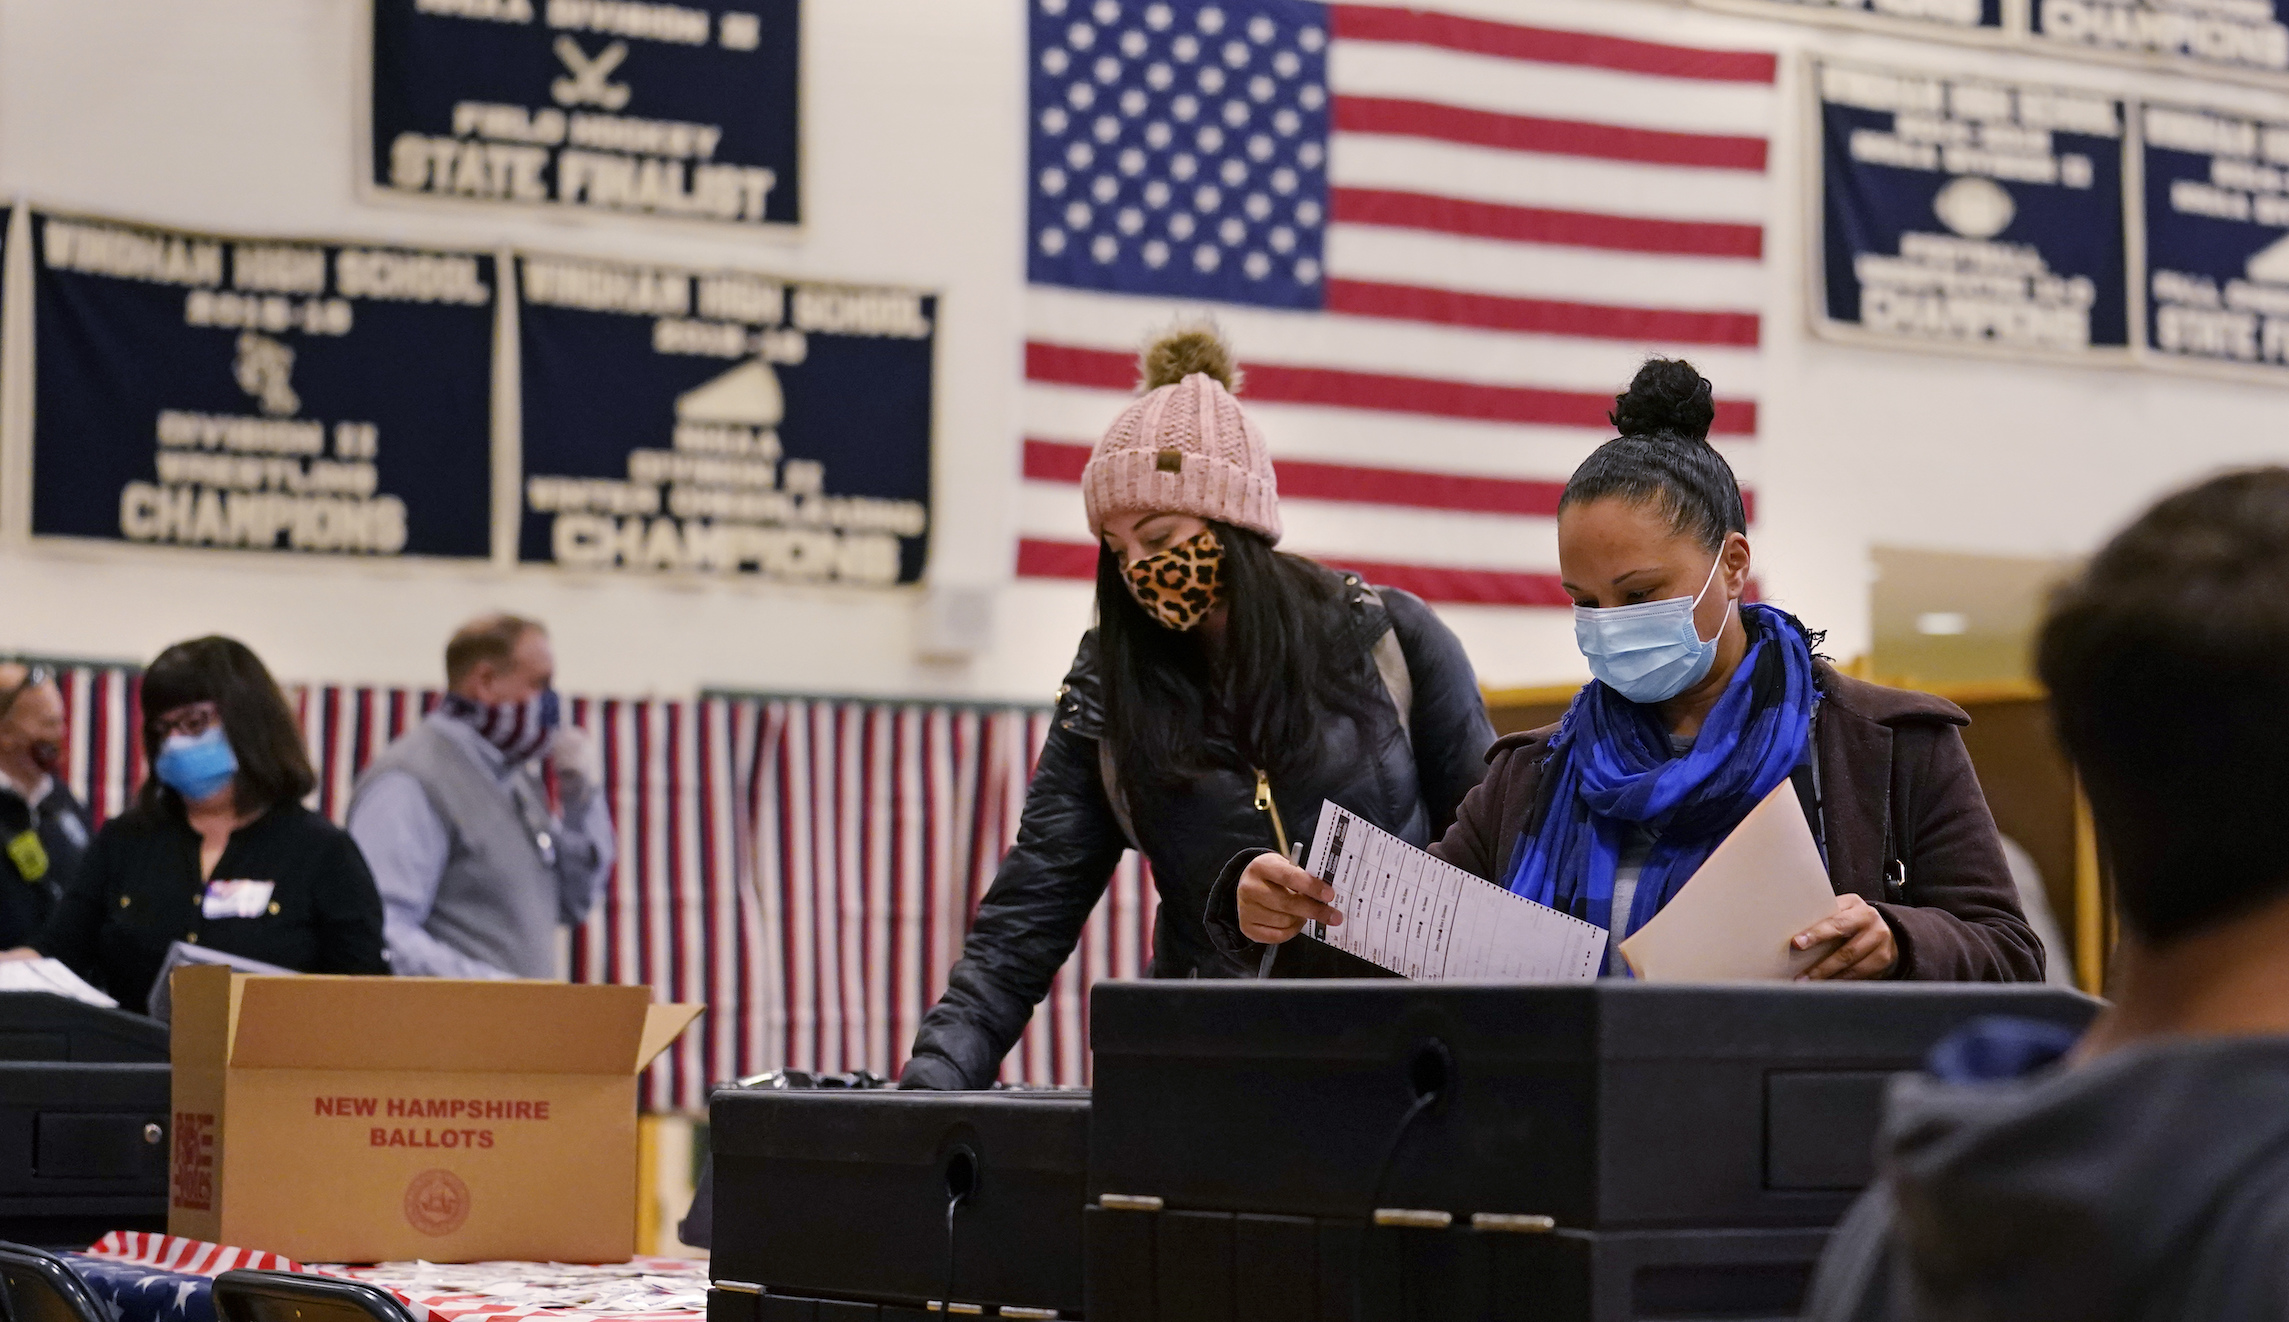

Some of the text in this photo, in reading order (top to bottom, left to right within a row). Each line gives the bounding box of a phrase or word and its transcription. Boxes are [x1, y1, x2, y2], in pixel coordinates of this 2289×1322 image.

[389, 132, 776, 221] STATE FINALIST
[336, 249, 490, 307] SCHOOL
[119, 480, 408, 554] CHAMPIONS
[551, 512, 900, 587] CHAMPIONS
[314, 1096, 550, 1120] NEW HAMPSHIRE
[370, 1128, 495, 1150] BALLOTS
